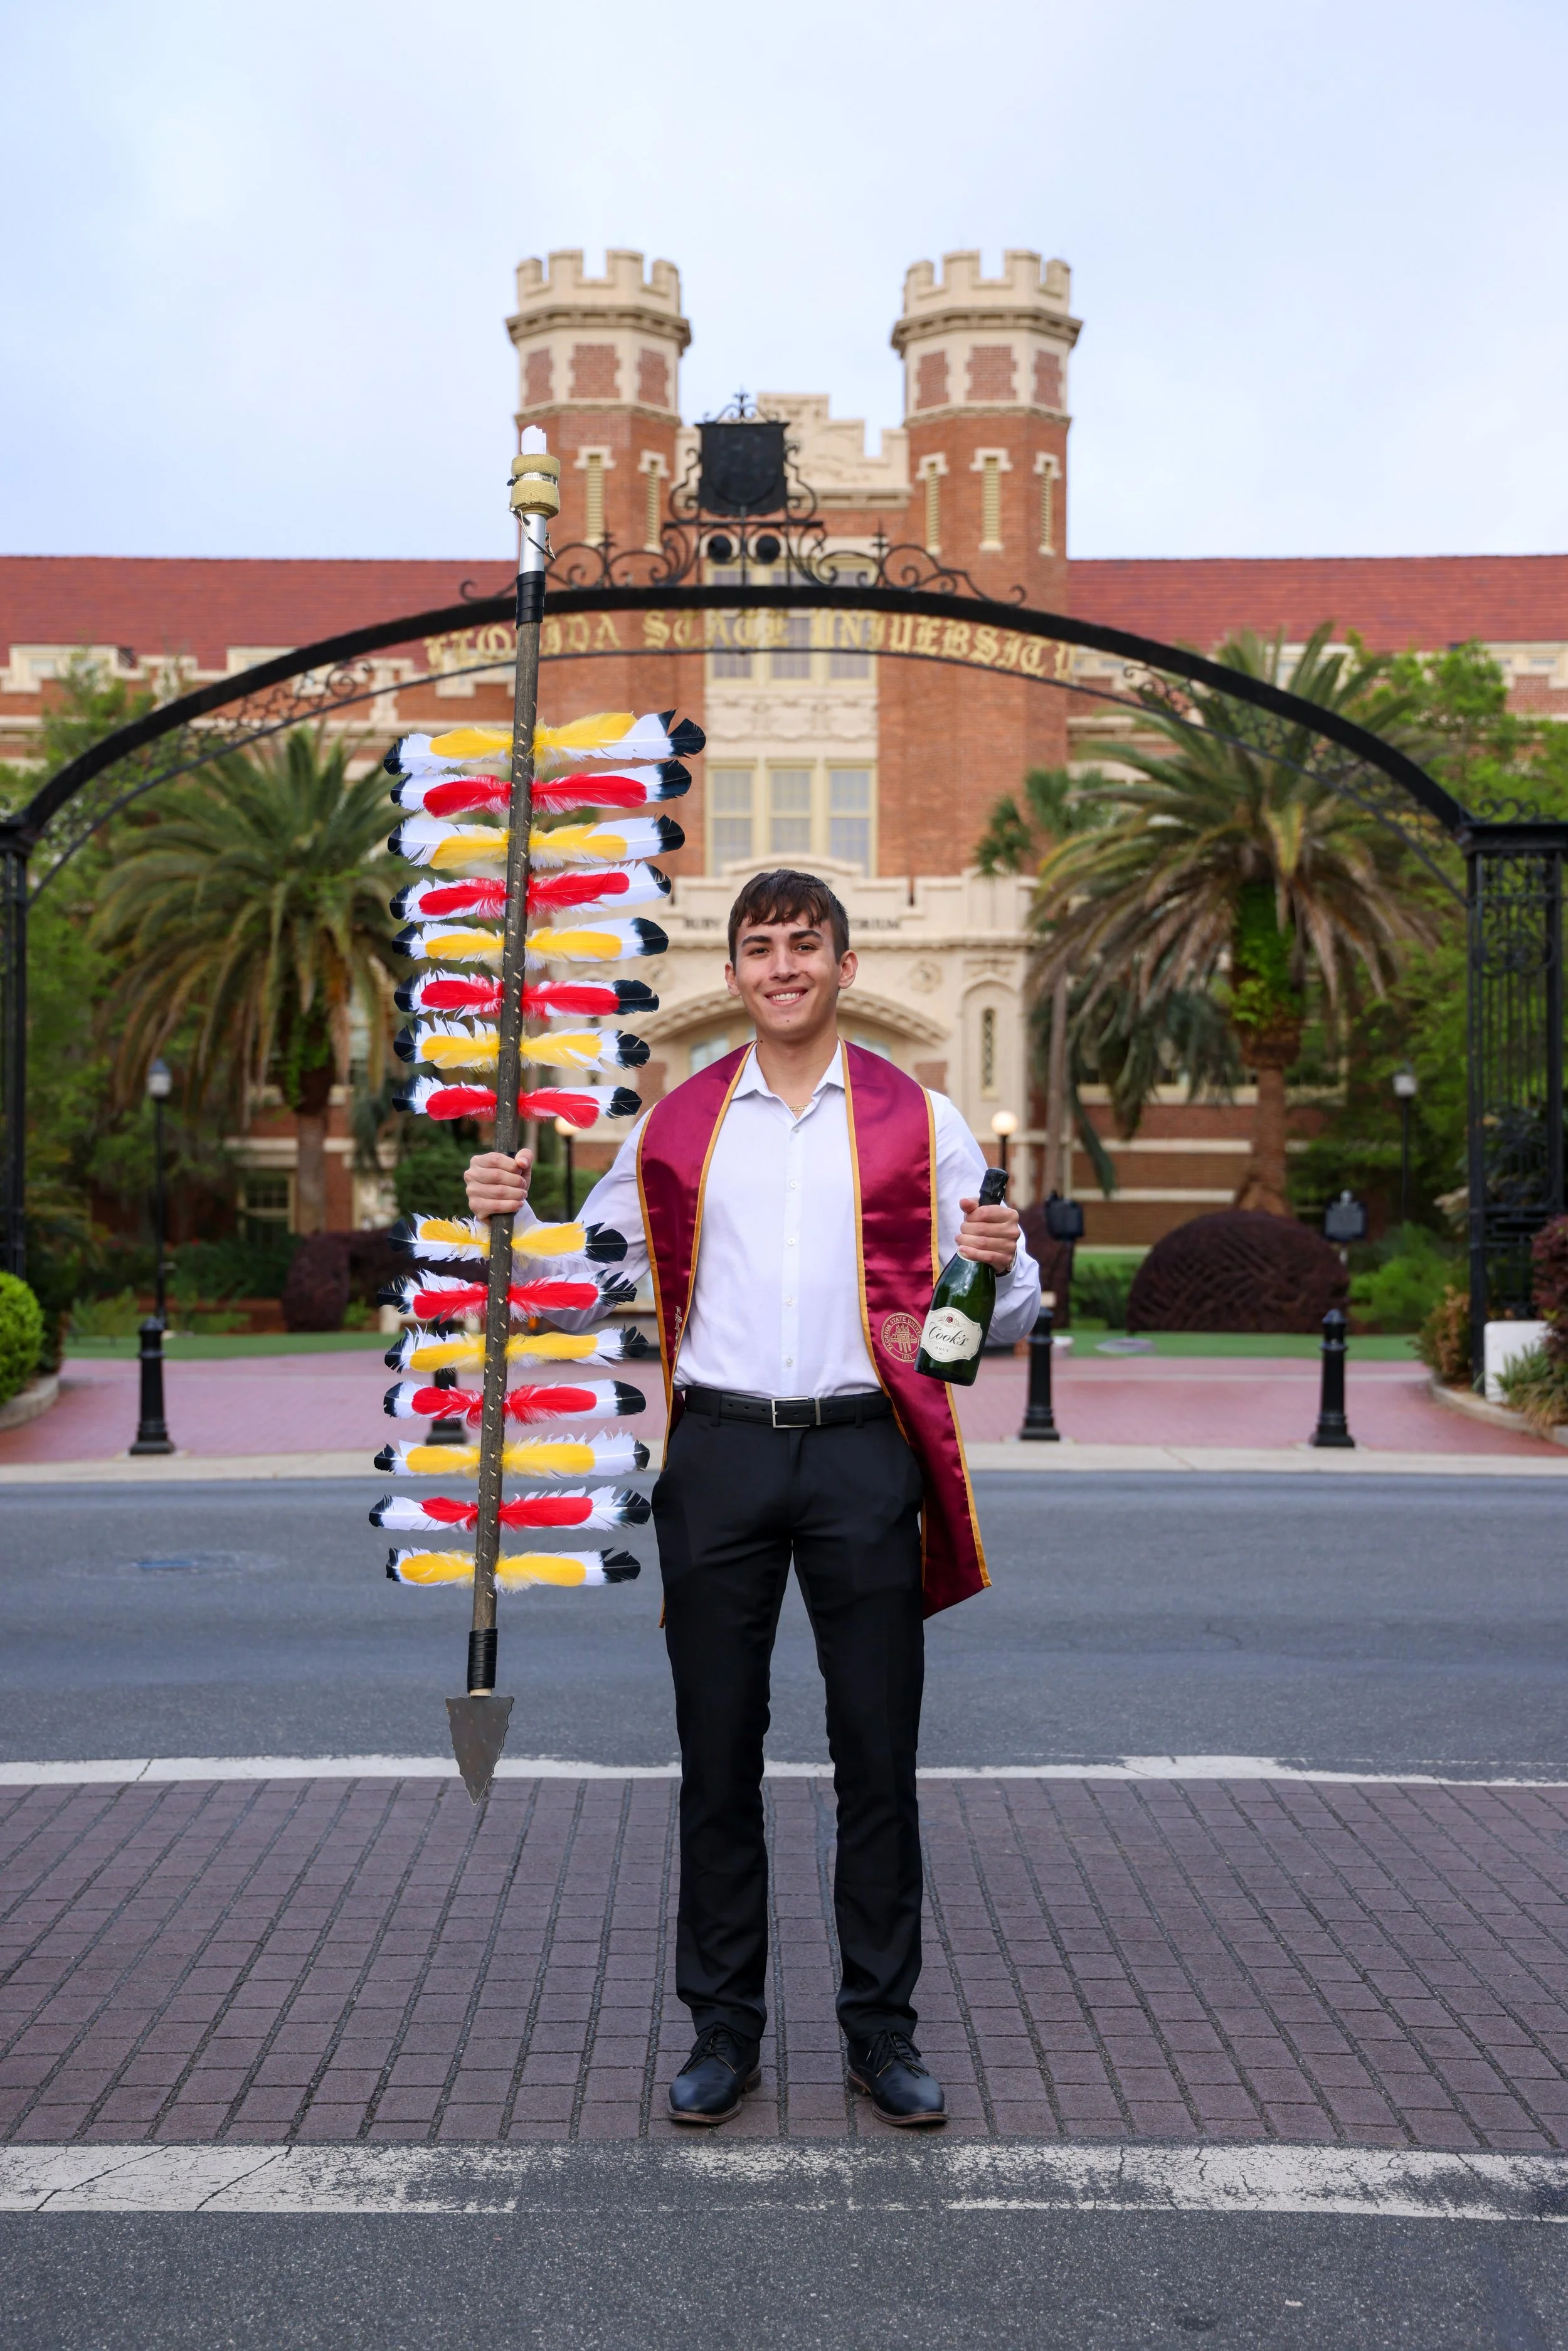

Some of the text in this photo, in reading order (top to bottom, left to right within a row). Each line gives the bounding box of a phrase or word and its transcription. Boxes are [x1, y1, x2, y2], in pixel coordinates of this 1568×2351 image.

[423, 607, 1078, 682] FLOIDA STATE UNIVERSITY
[884, 1316, 922, 1351] FLORIDA STATE UNIVER
[929, 1322, 970, 1346] Cook's
